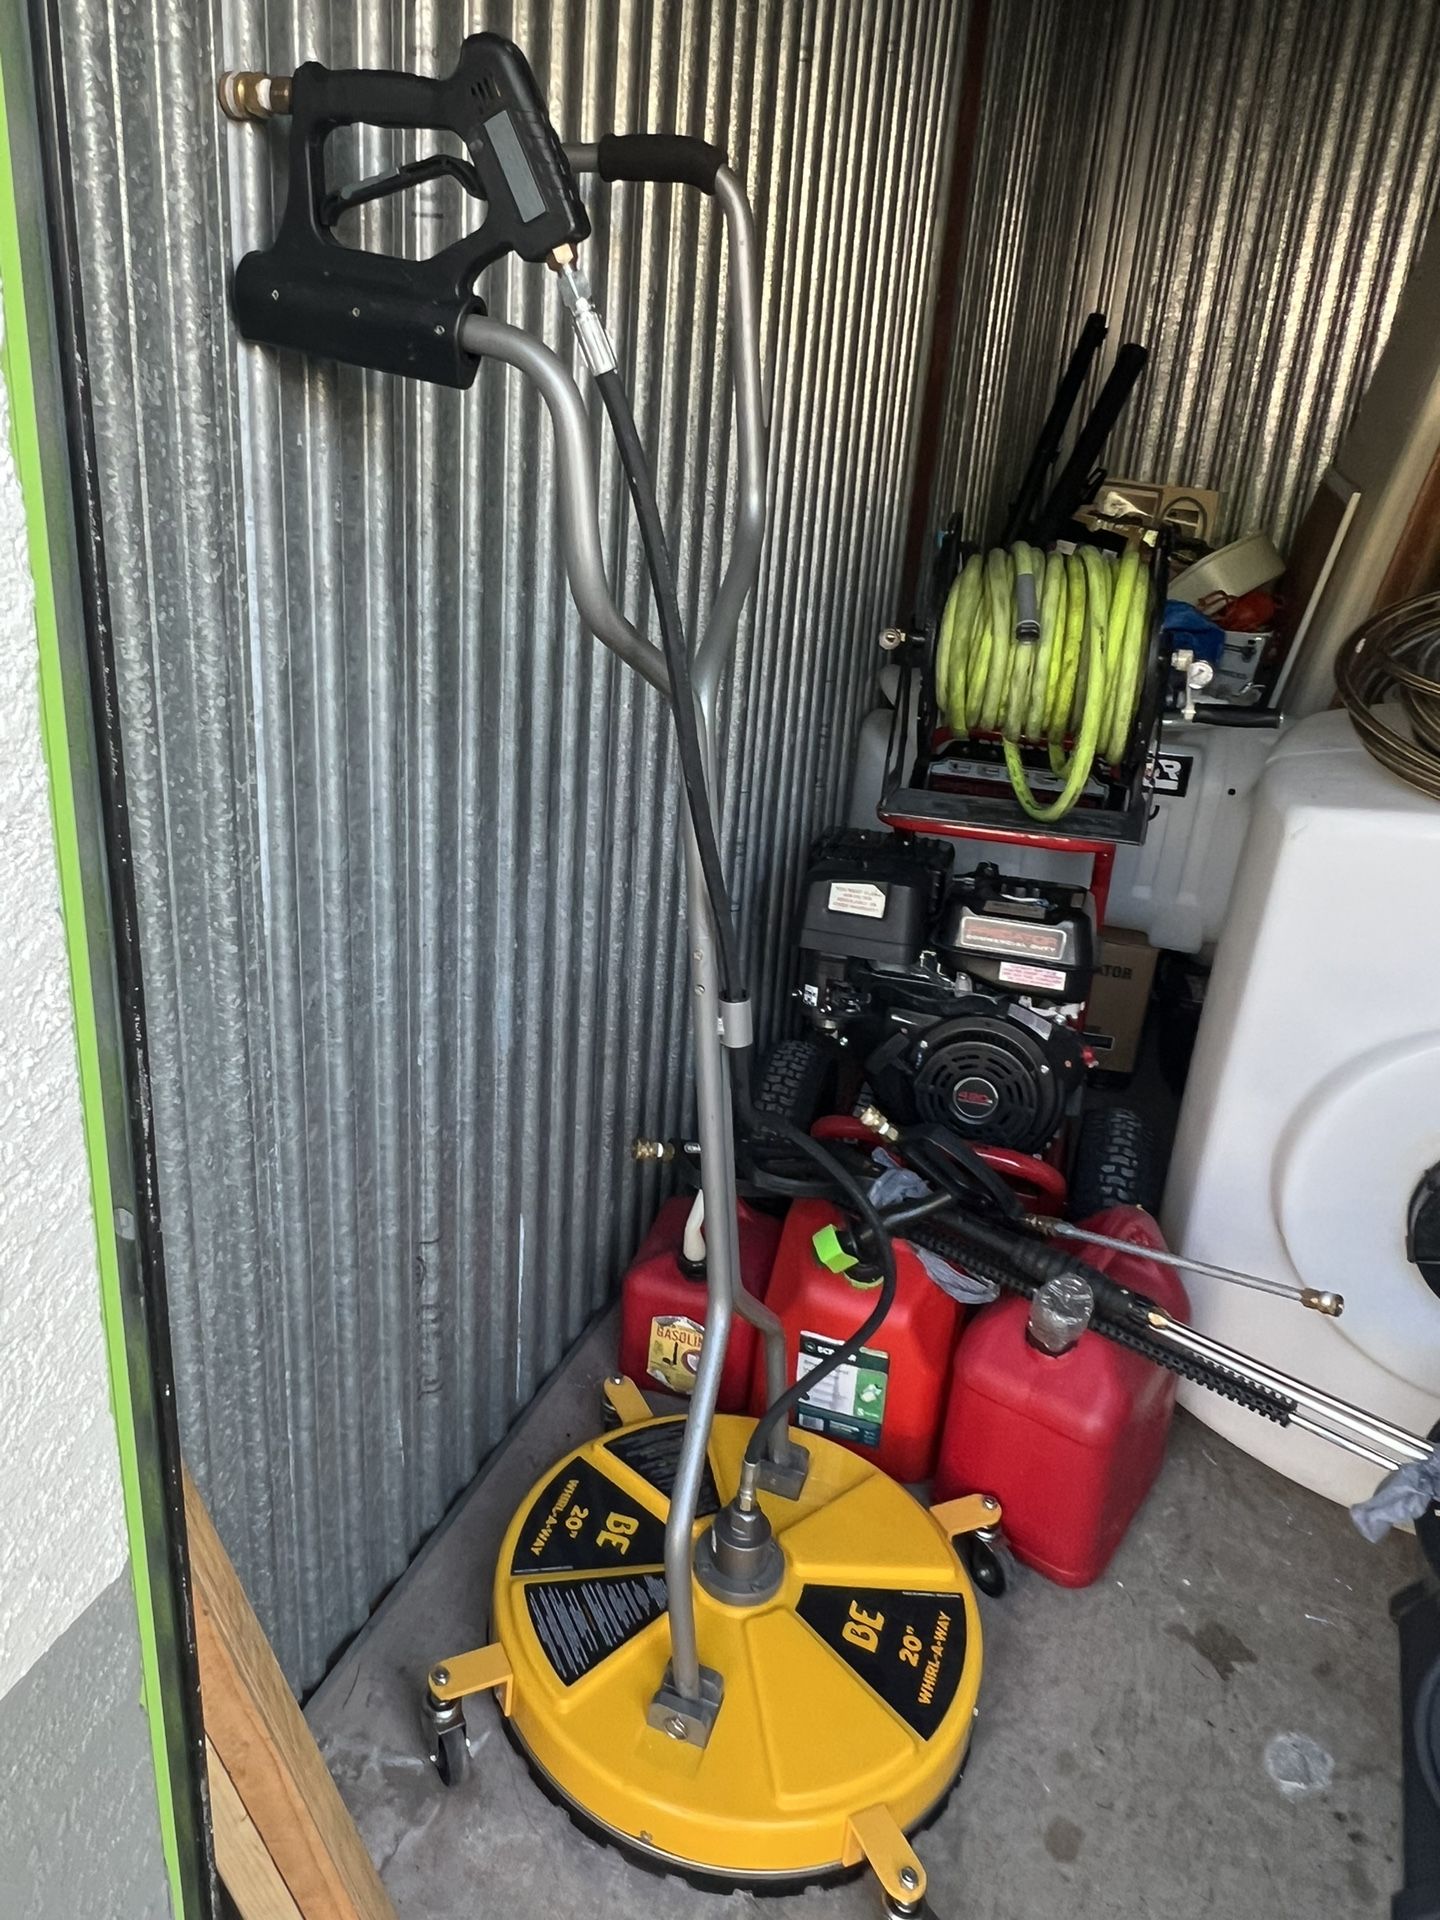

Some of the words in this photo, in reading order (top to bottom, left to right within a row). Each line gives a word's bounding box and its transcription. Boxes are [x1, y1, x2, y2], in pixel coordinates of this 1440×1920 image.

[530, 1479, 579, 1556] WHIRL-A-WAY
[595, 1511, 639, 1555] BE
[841, 1599, 885, 1653] BE
[917, 1610, 952, 1705] WHIRL-A-WAY
